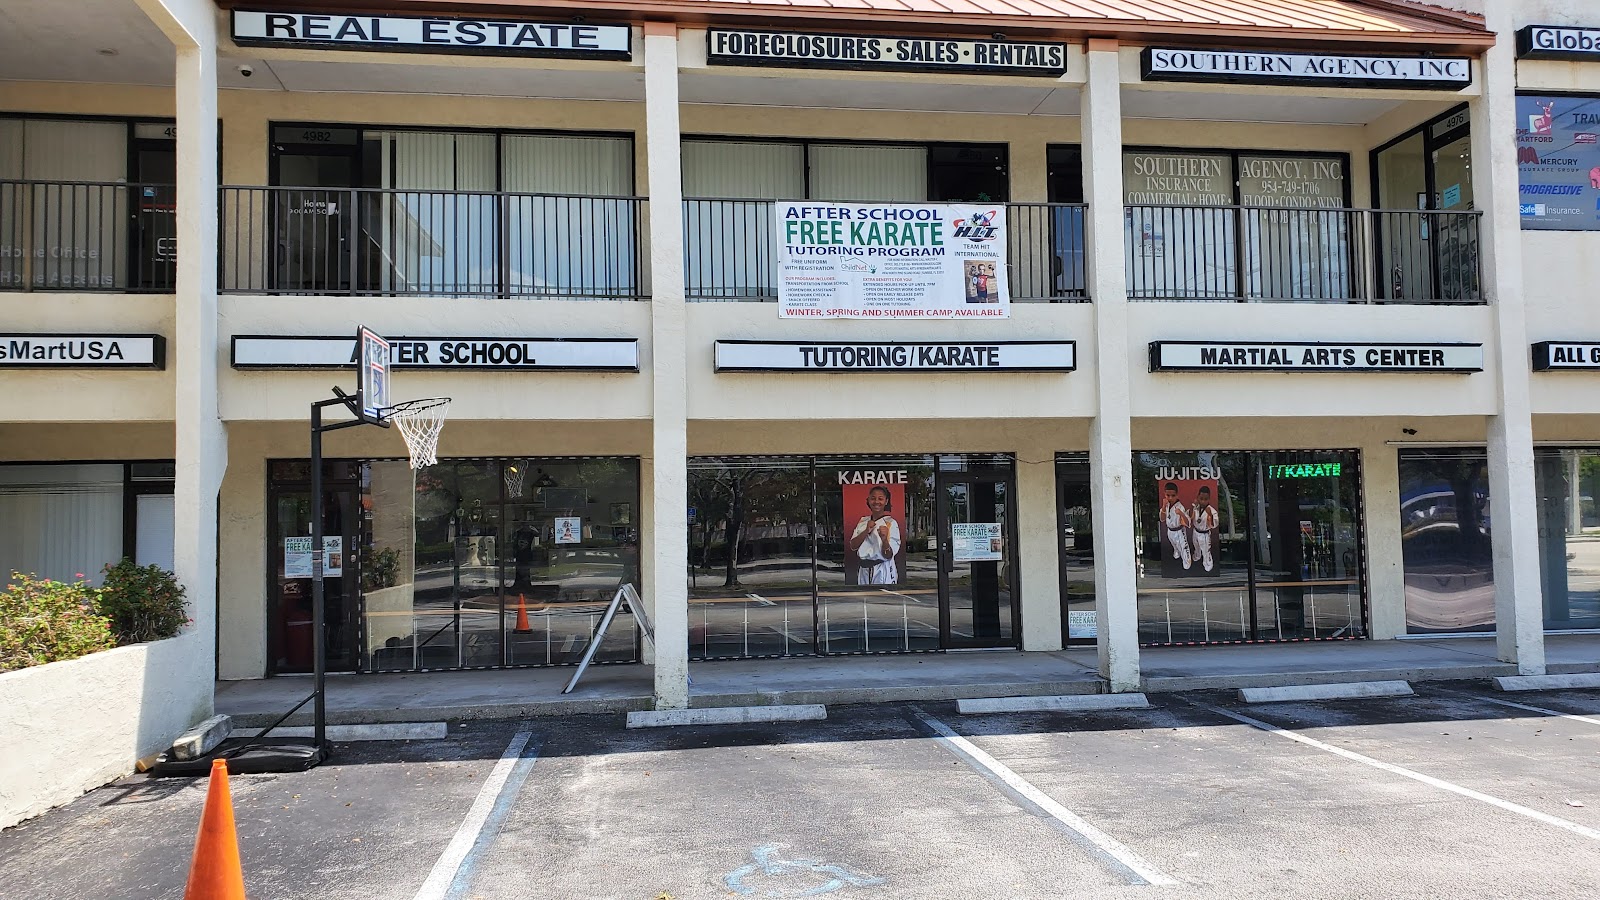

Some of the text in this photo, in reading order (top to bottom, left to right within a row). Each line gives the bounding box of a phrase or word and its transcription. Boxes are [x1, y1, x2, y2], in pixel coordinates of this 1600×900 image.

[265, 14, 599, 48] REAL ESTATE
[717, 33, 1061, 67] FORECLOSURES SALES RENTALS
[1155, 52, 1466, 79] SOUTHERN AGENCY, INC.
[1446, 113, 1464, 129] 4976
[303, 131, 331, 142] 4982
[1134, 156, 1344, 181] SOUTHERN AGENCY, INC.
[1540, 158, 1578, 166] MERCURY
[1146, 176, 1320, 195] INSURANCE 954-749-1706
[1519, 184, 1583, 195] PROGRESSIVE
[1128, 192, 1343, 208] COMMERCIAL HOME FLOOD CONDO WIND
[785, 207, 943, 221] AFTER SCHOOL
[1546, 206, 1581, 215] Insurance
[785, 220, 944, 246] FREE KARATE
[0, 245, 45, 258] Hoe
[785, 246, 945, 257] TUTORING PROGRAM
[840, 263, 867, 271] ChildNet
[0, 270, 45, 284] Hoe
[785, 308, 824, 317] WINTER,
[826, 308, 860, 316] SPRING
[861, 309, 882, 317] AND
[884, 309, 924, 317] SUMMER
[439, 342, 536, 365] SCHOOL
[1200, 347, 1445, 366] MARTIAL ARTS CENTER
[1553, 347, 1586, 363] ALL
[838, 470, 908, 485] KARATE
[1155, 466, 1221, 480] JU-JITSU
[286, 543, 301, 551] FREE
[1070, 616, 1083, 624] FREE
